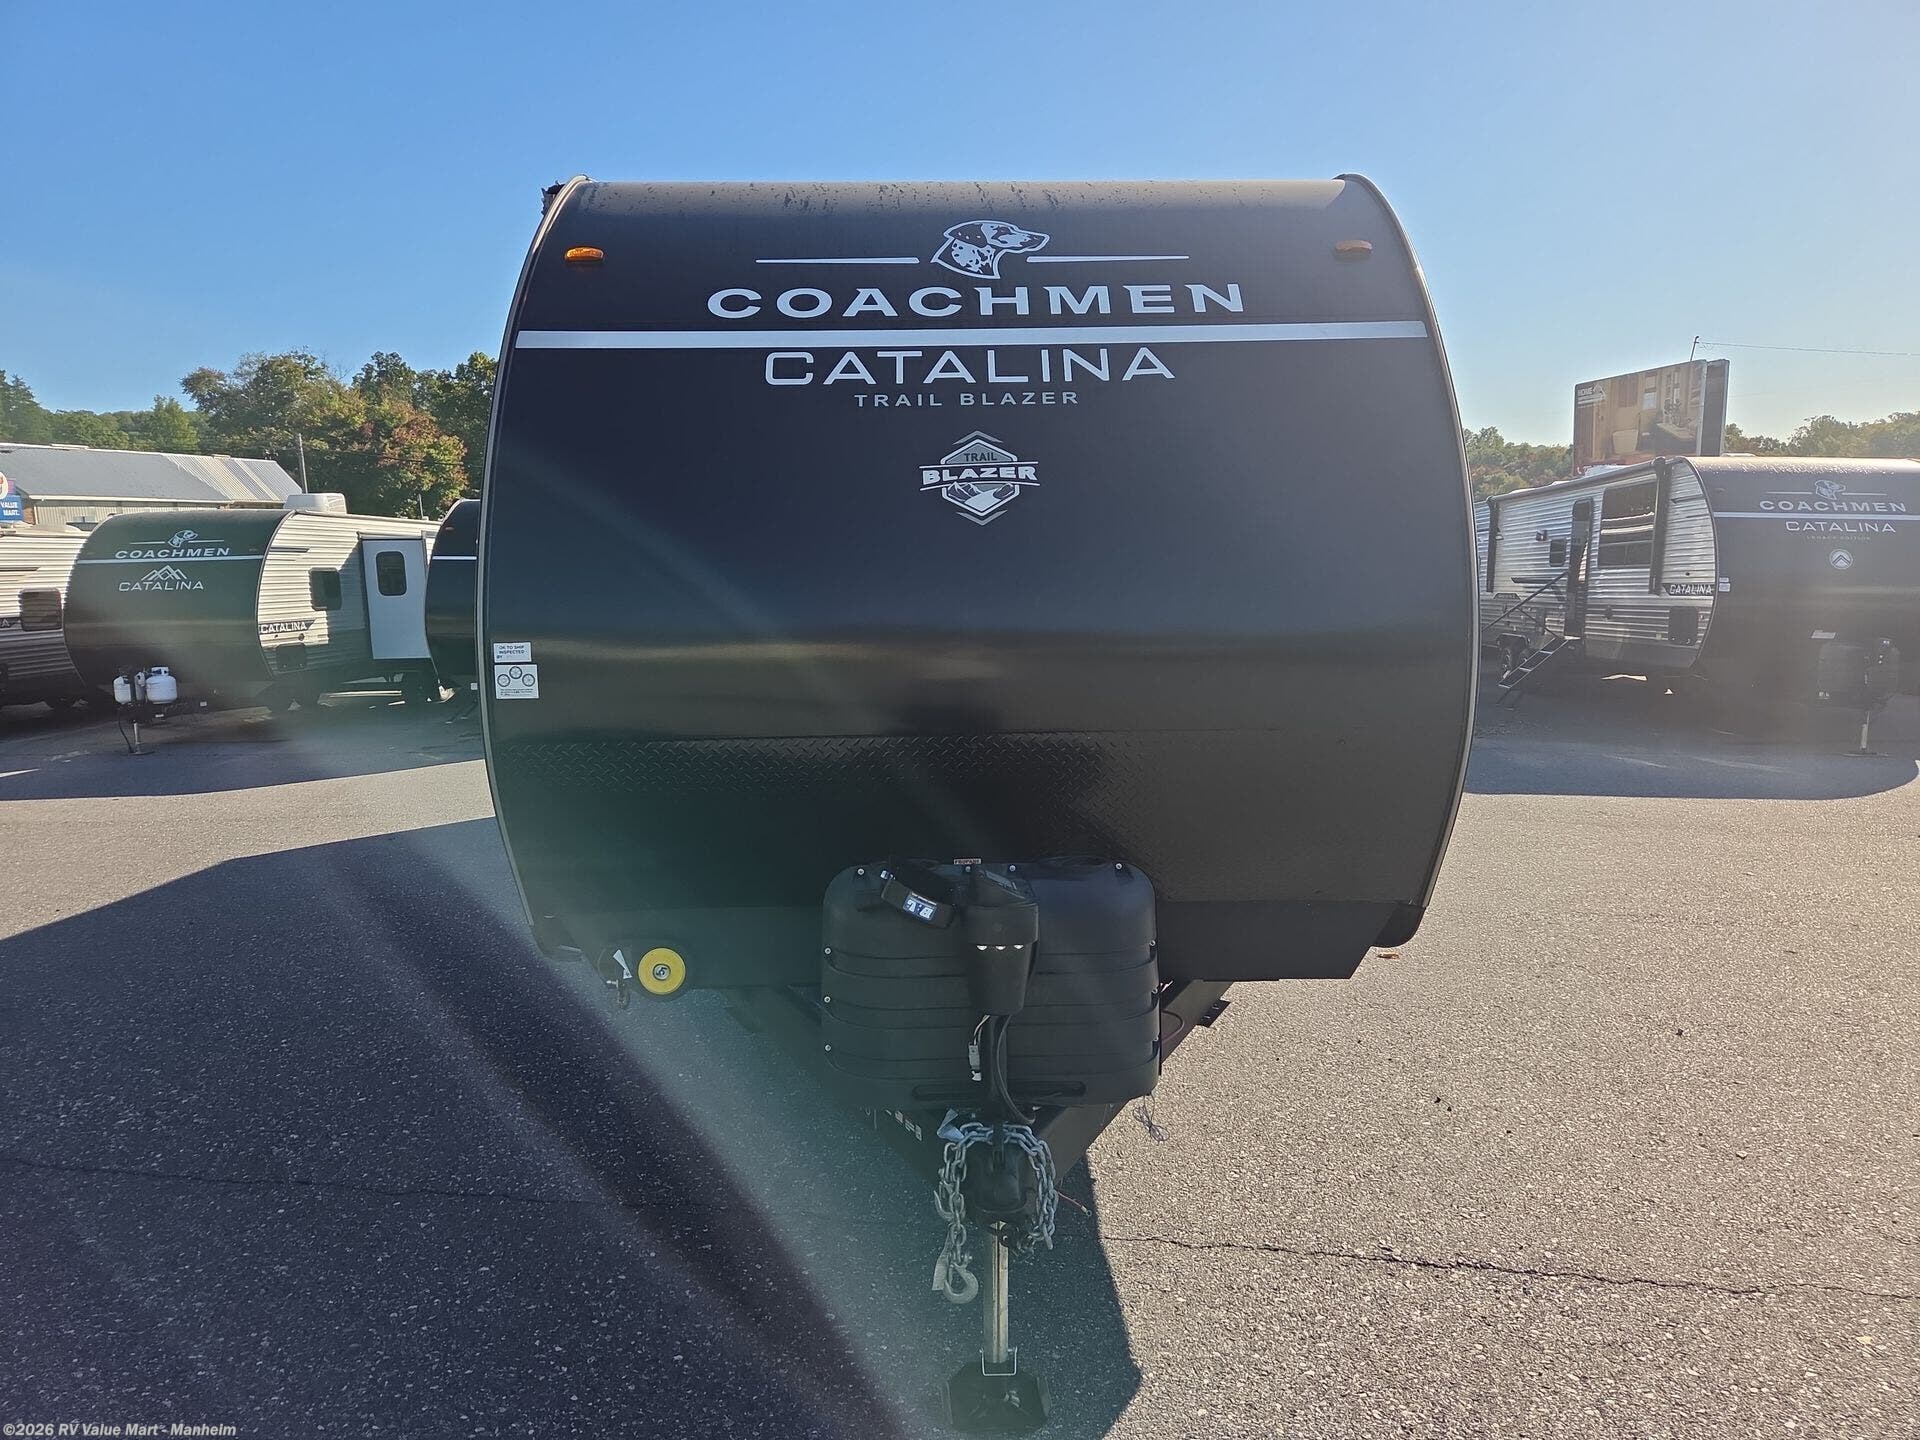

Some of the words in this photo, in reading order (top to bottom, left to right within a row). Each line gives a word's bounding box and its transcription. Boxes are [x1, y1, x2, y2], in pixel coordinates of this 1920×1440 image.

[707, 283, 1244, 318] COACHMEN
[765, 347, 1175, 385] CATALINA
[854, 393, 942, 407] TRAIL
[960, 391, 1079, 406] BLAZER
[964, 452, 998, 462] TRAIL
[922, 466, 1038, 485] BLAZER
[1759, 500, 1907, 512] COACHMEN
[1785, 521, 1897, 533] CATALINA
[115, 547, 230, 559] COACHMEN
[118, 581, 204, 592] CATALINA
[1669, 584, 1713, 595] CATALINA
[260, 621, 308, 634] CATALINA
